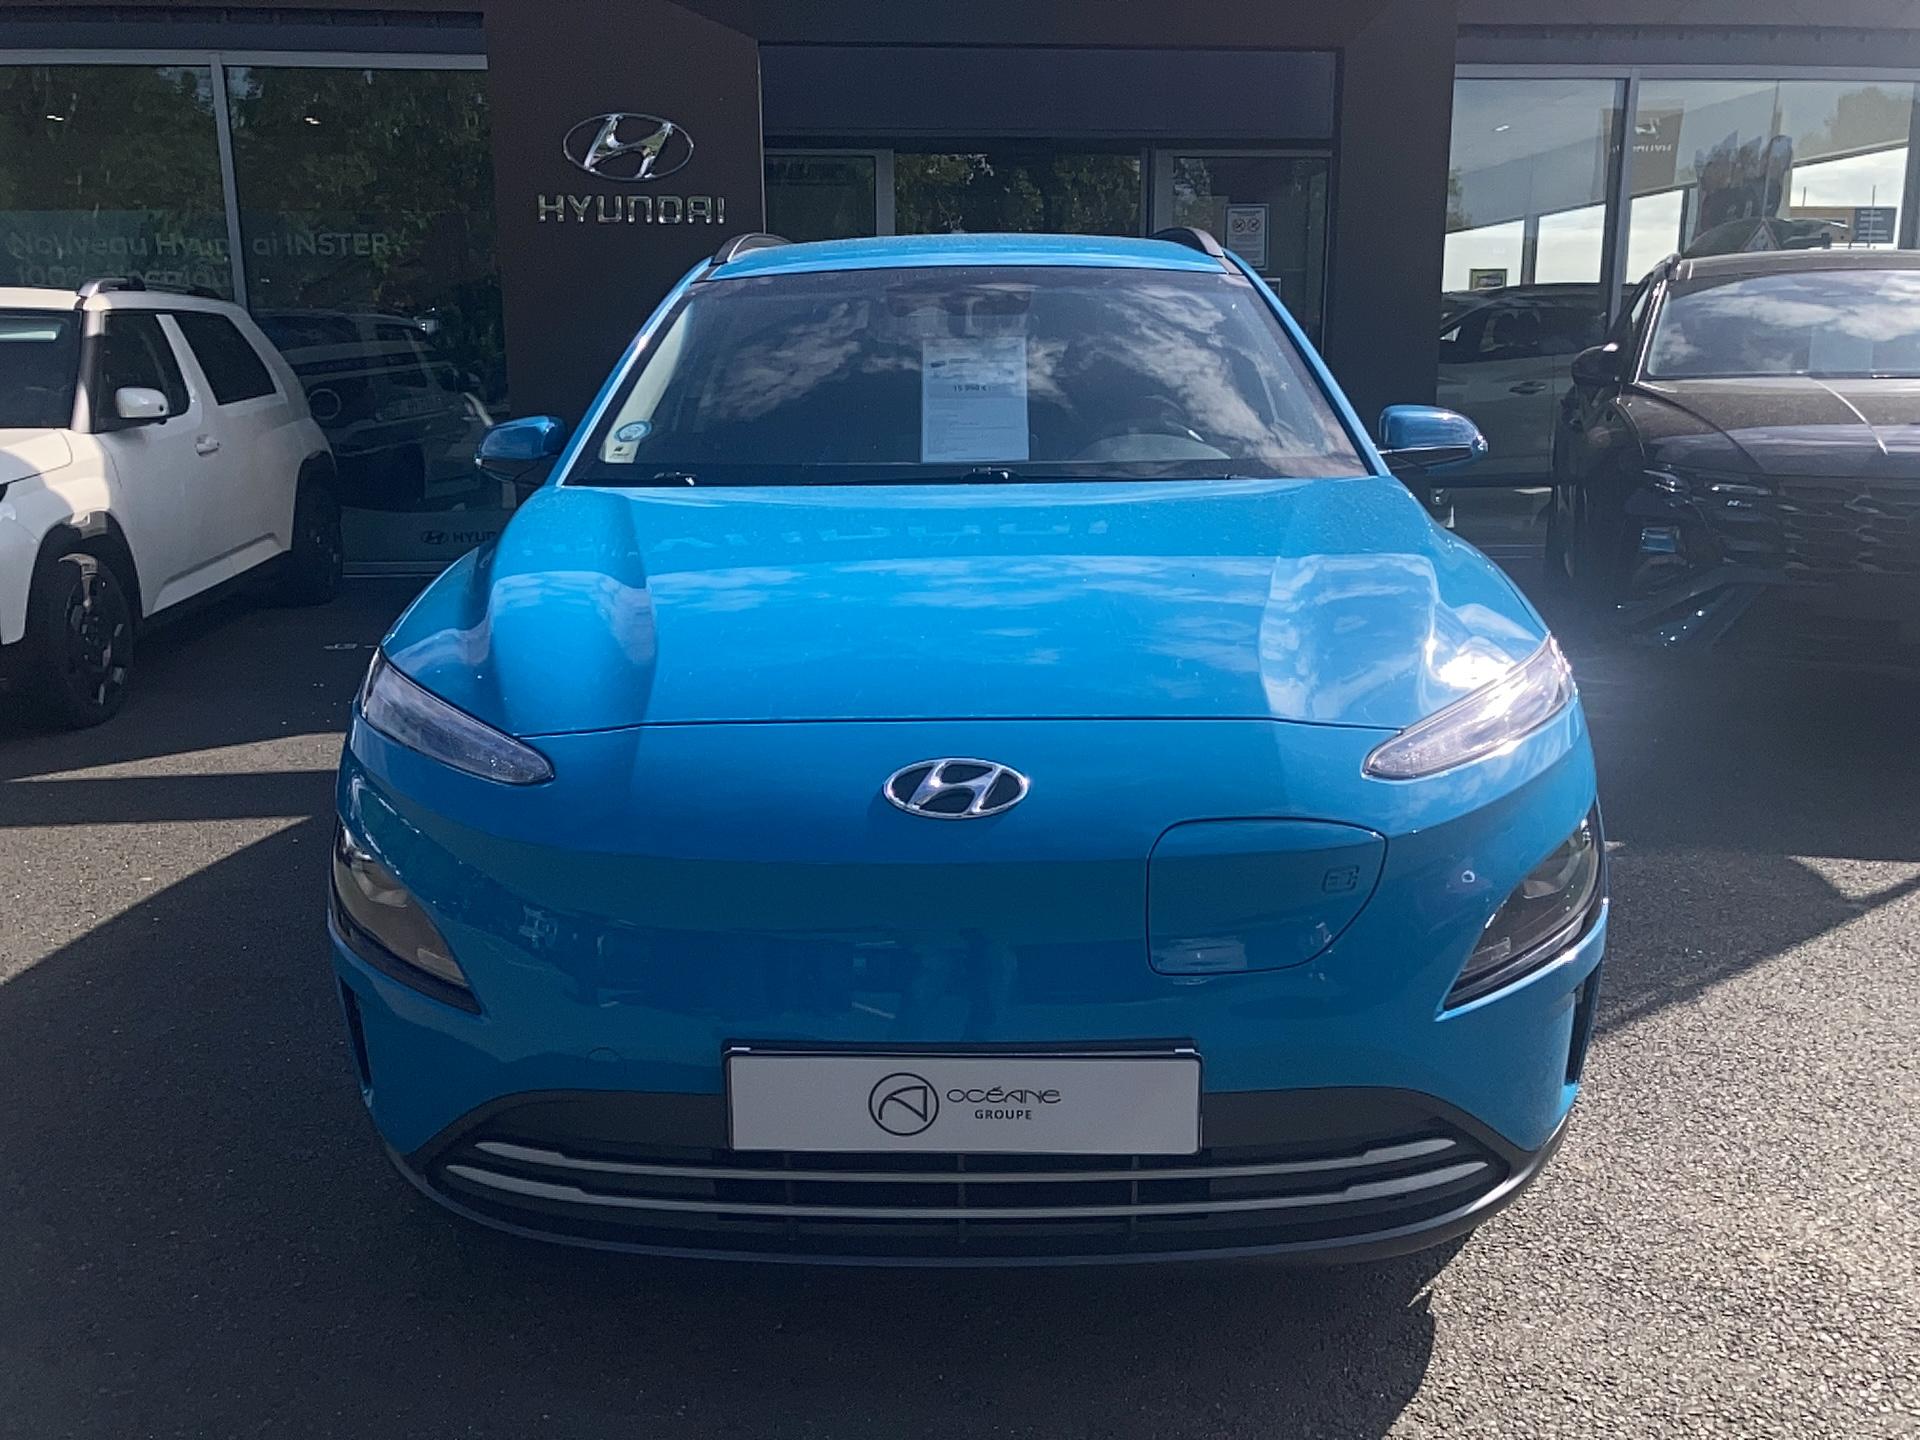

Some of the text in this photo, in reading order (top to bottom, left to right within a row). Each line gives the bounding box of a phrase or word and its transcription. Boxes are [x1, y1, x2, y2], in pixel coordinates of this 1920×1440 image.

[537, 194, 726, 223] HYUNDAI
[286, 232, 388, 257] INSTER
[974, 1109, 1032, 1121] GROUPE
